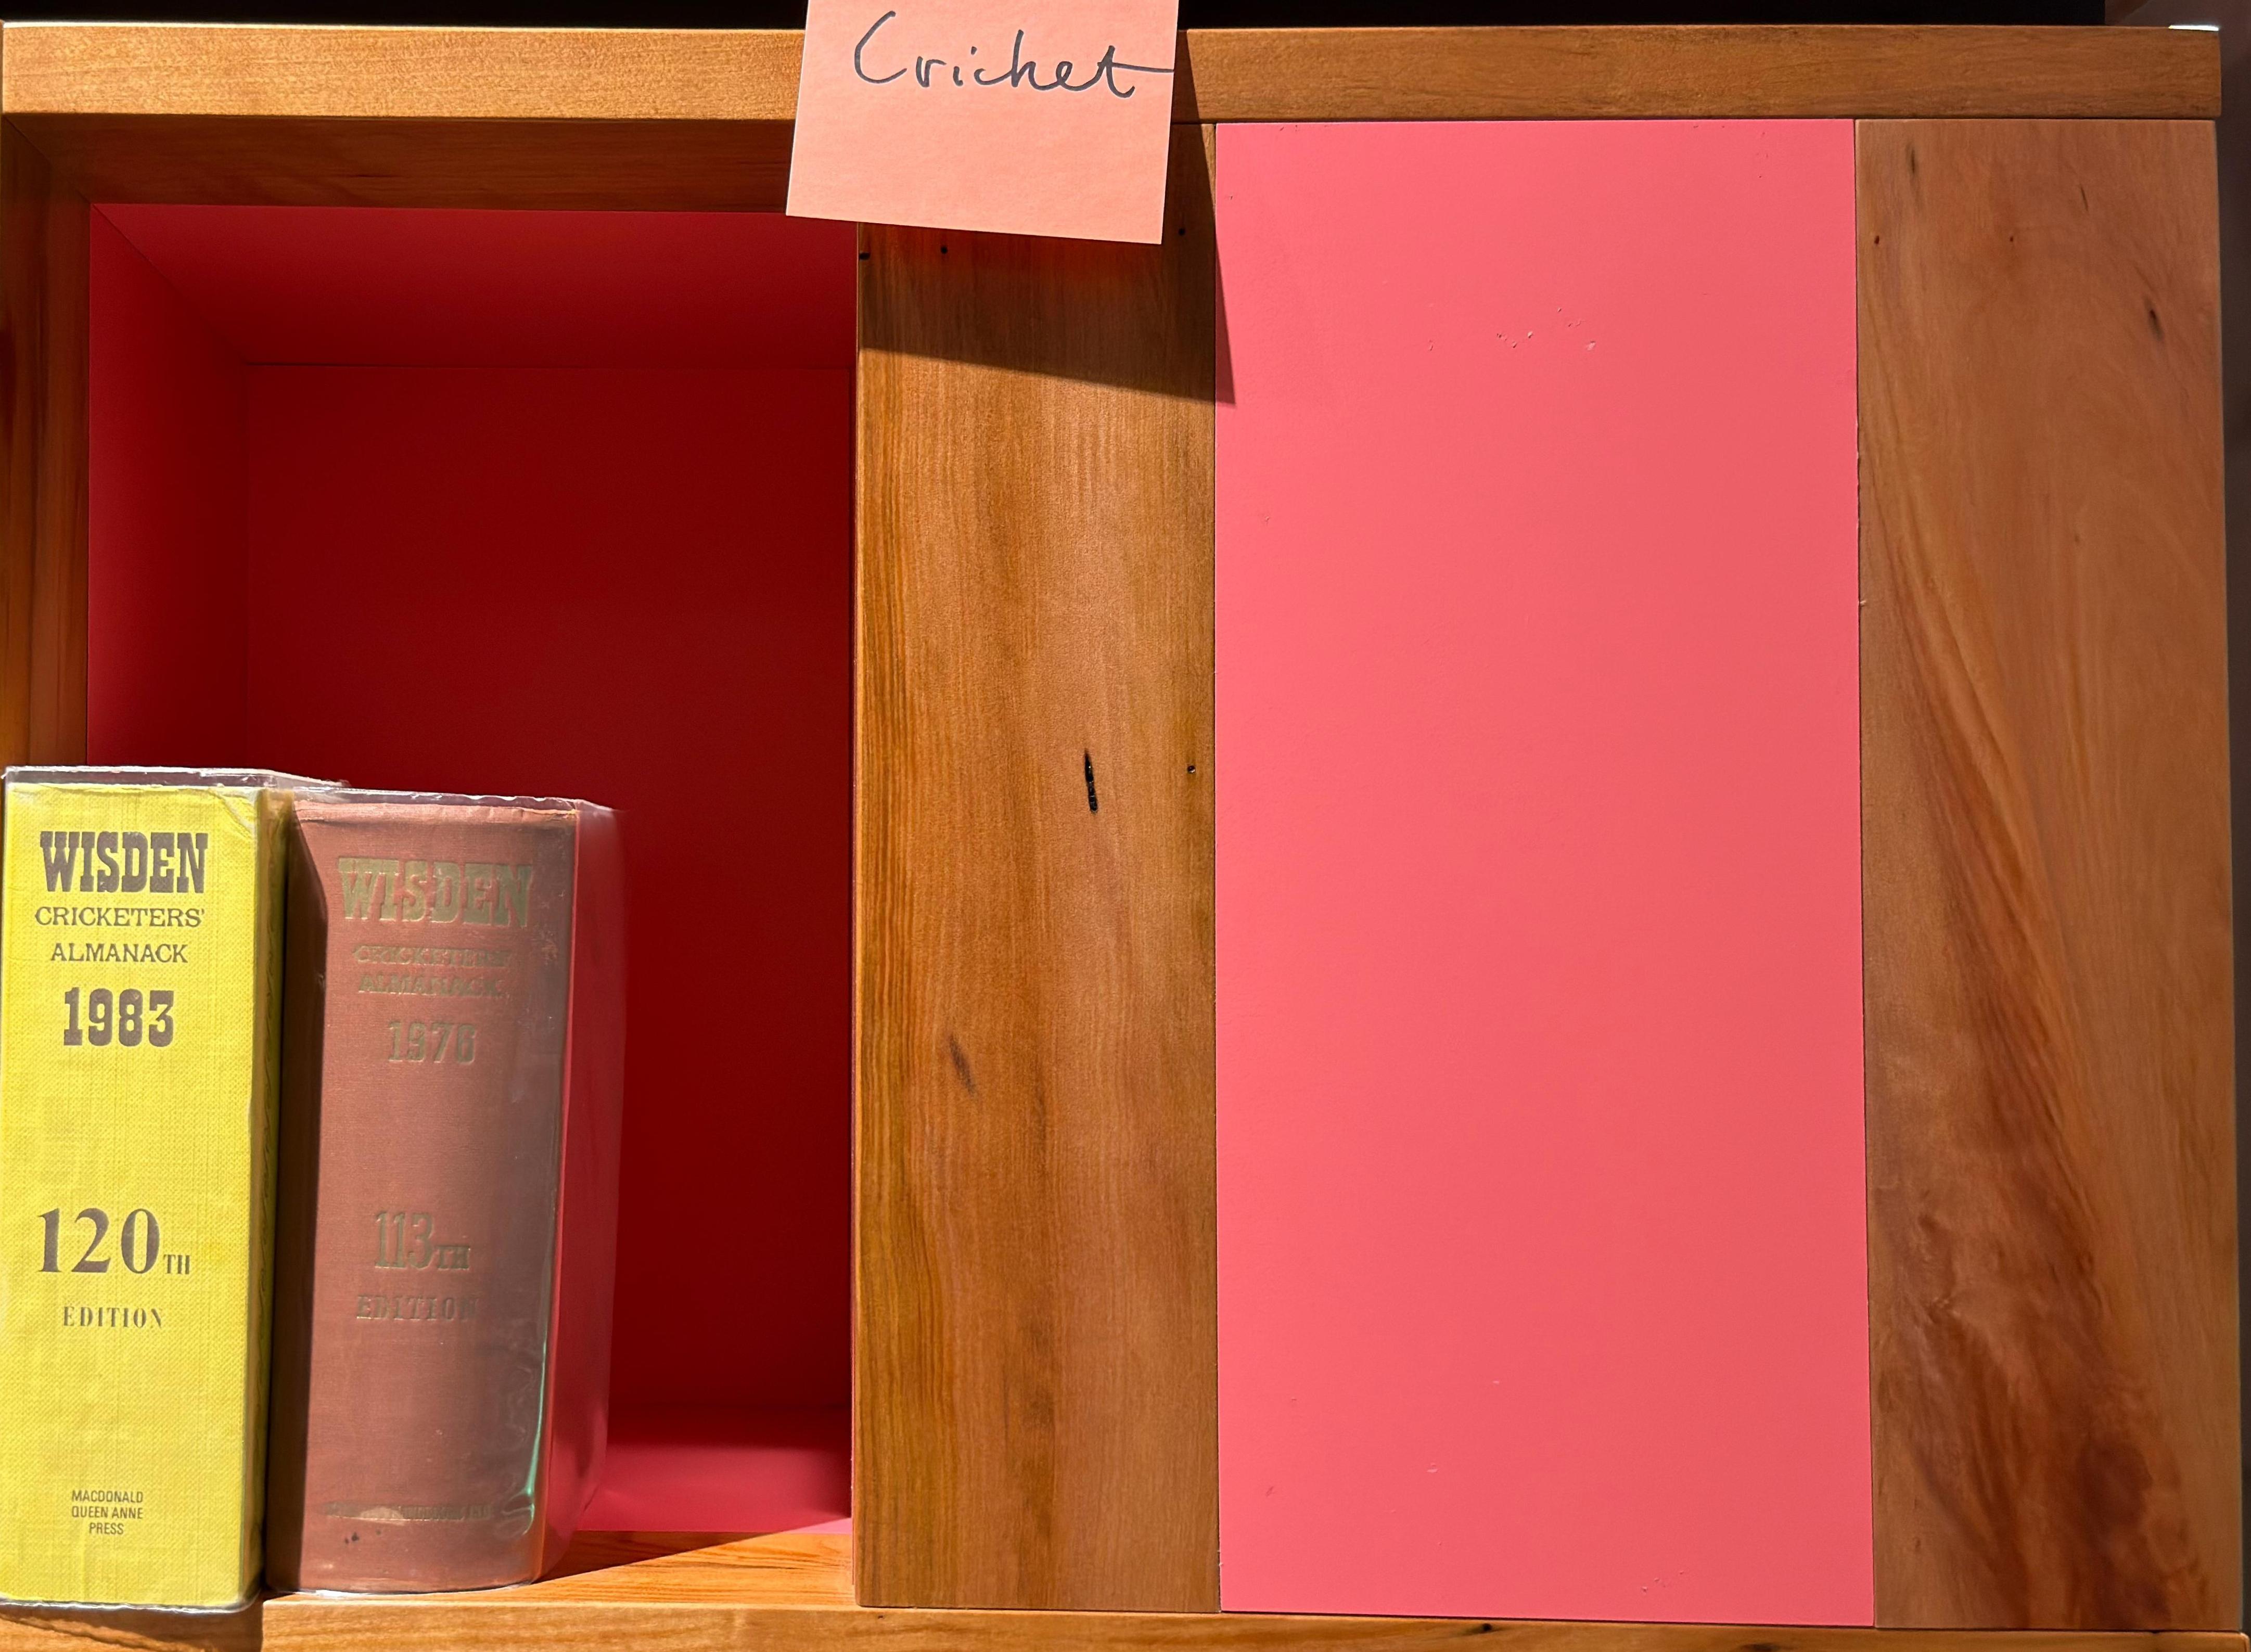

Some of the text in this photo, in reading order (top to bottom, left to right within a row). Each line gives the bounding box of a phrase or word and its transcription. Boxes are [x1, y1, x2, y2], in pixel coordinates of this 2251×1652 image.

[854, 10, 1174, 98] Cricket
[40, 830, 209, 893] WISDEN
[337, 856, 533, 928] WISDEN
[34, 906, 205, 928] CRICKETERS'
[51, 942, 188, 963] ALMANACK
[63, 987, 175, 1047] 1983
[387, 1020, 477, 1064] 1976
[63, 1306, 162, 1328] EDITION
[356, 1294, 480, 1322] EDITION
[71, 1490, 144, 1503] MACDONALD
[71, 1505, 144, 1519] QUEEN ANNE
[88, 1522, 124, 1535] PRESS
